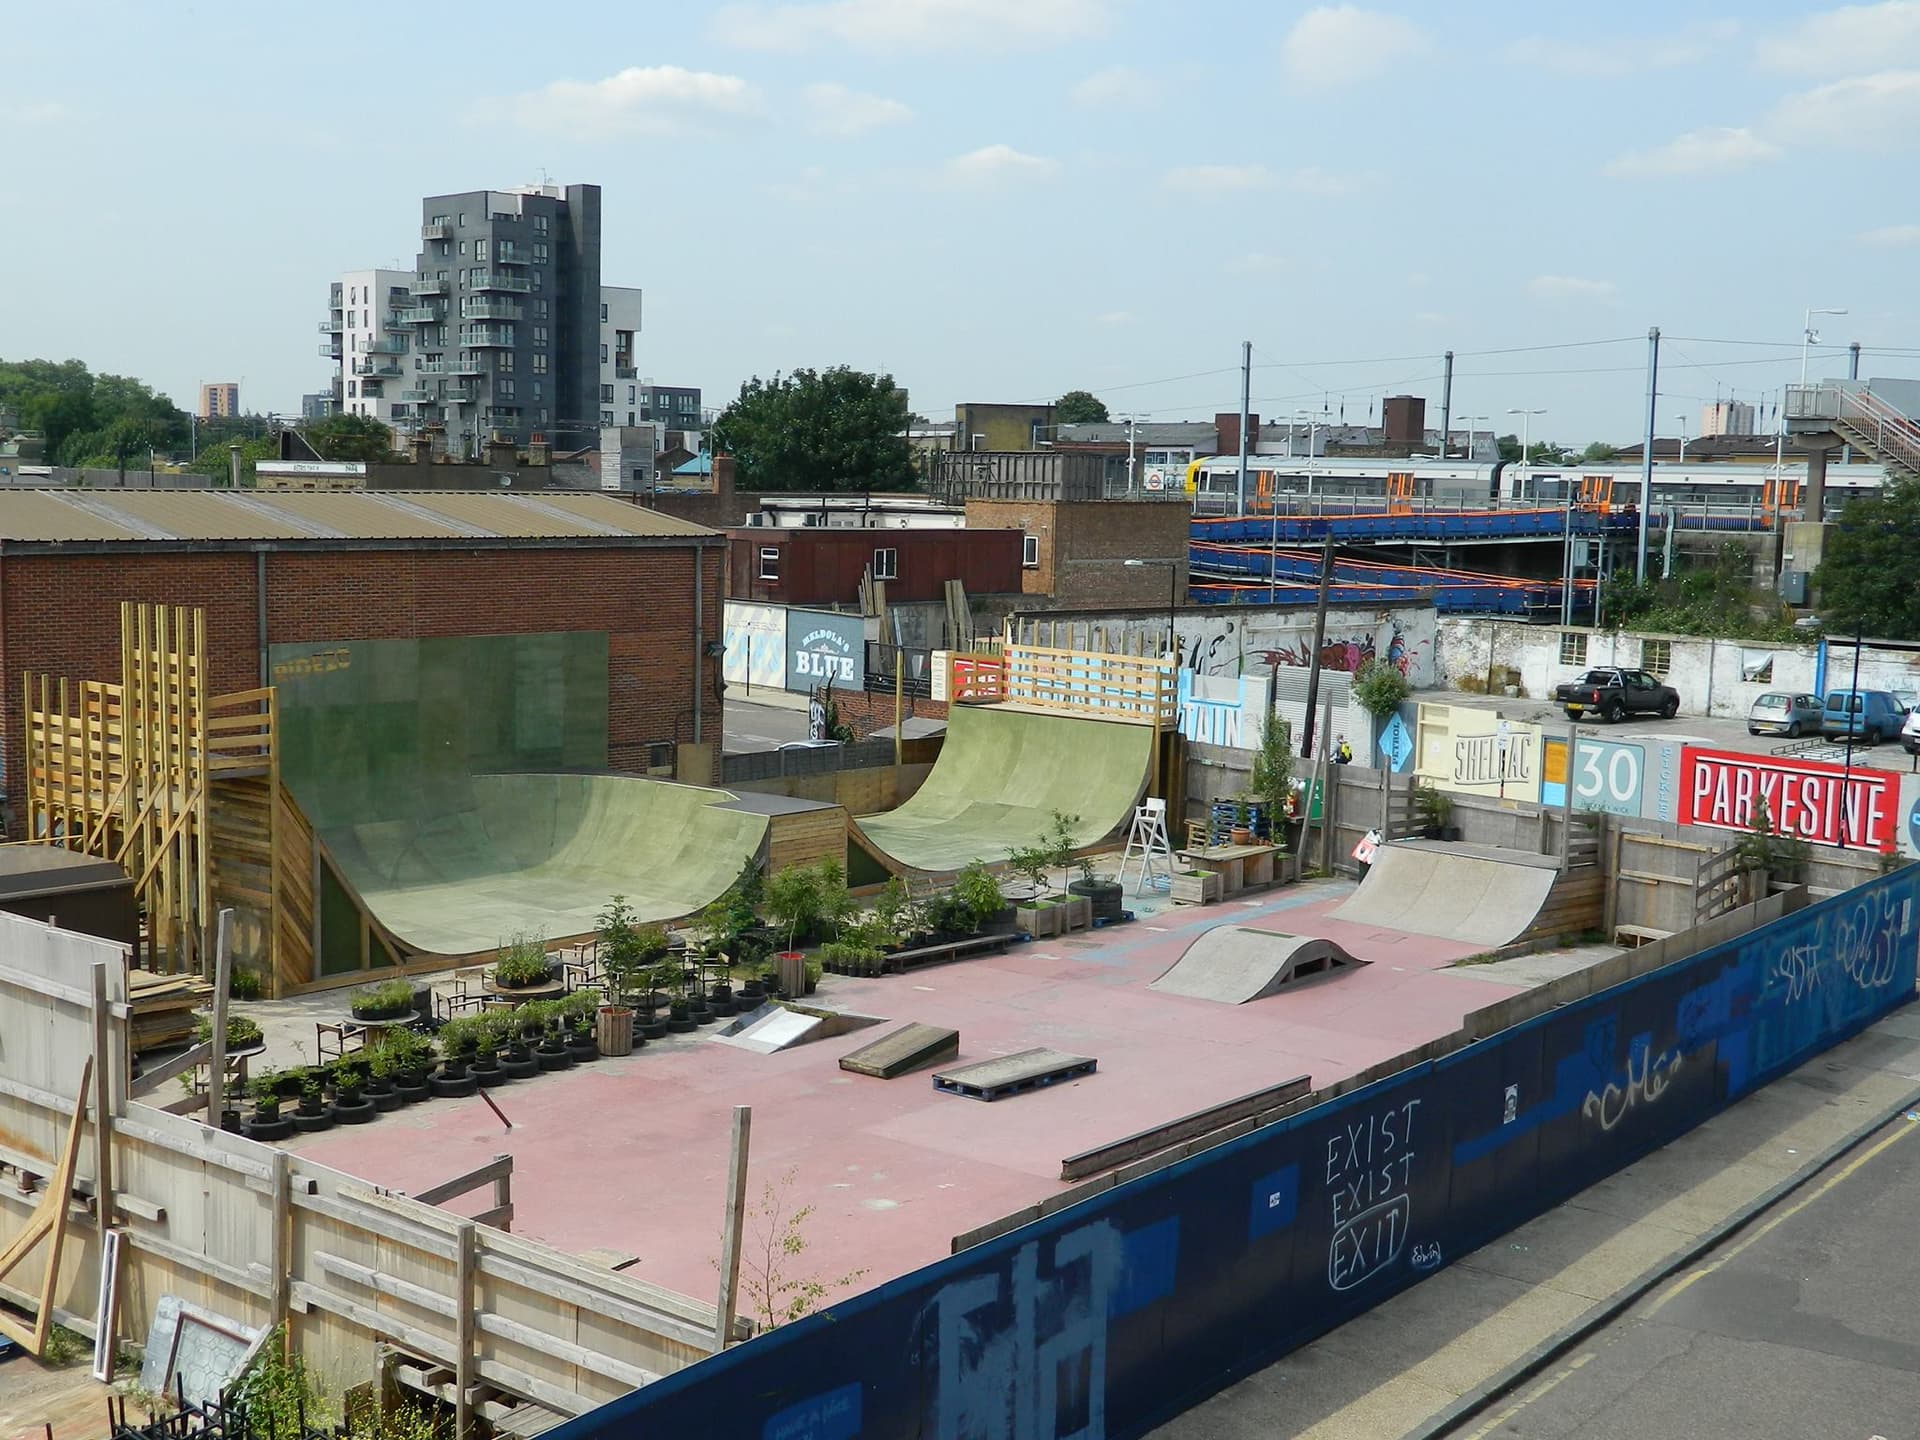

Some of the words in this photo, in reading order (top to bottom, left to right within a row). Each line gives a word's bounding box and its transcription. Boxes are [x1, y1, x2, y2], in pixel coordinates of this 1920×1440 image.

[795, 651, 854, 681] BLUE
[1180, 703, 1241, 748] TAIN
[1454, 734, 1532, 782] SHELAC
[1576, 744, 1638, 801] 30
[1692, 762, 1886, 846] PARKESINE
[1327, 1099, 1421, 1185] EXIST
[1333, 1152, 1415, 1229] EXIST
[1334, 1208, 1399, 1286] EXIT
